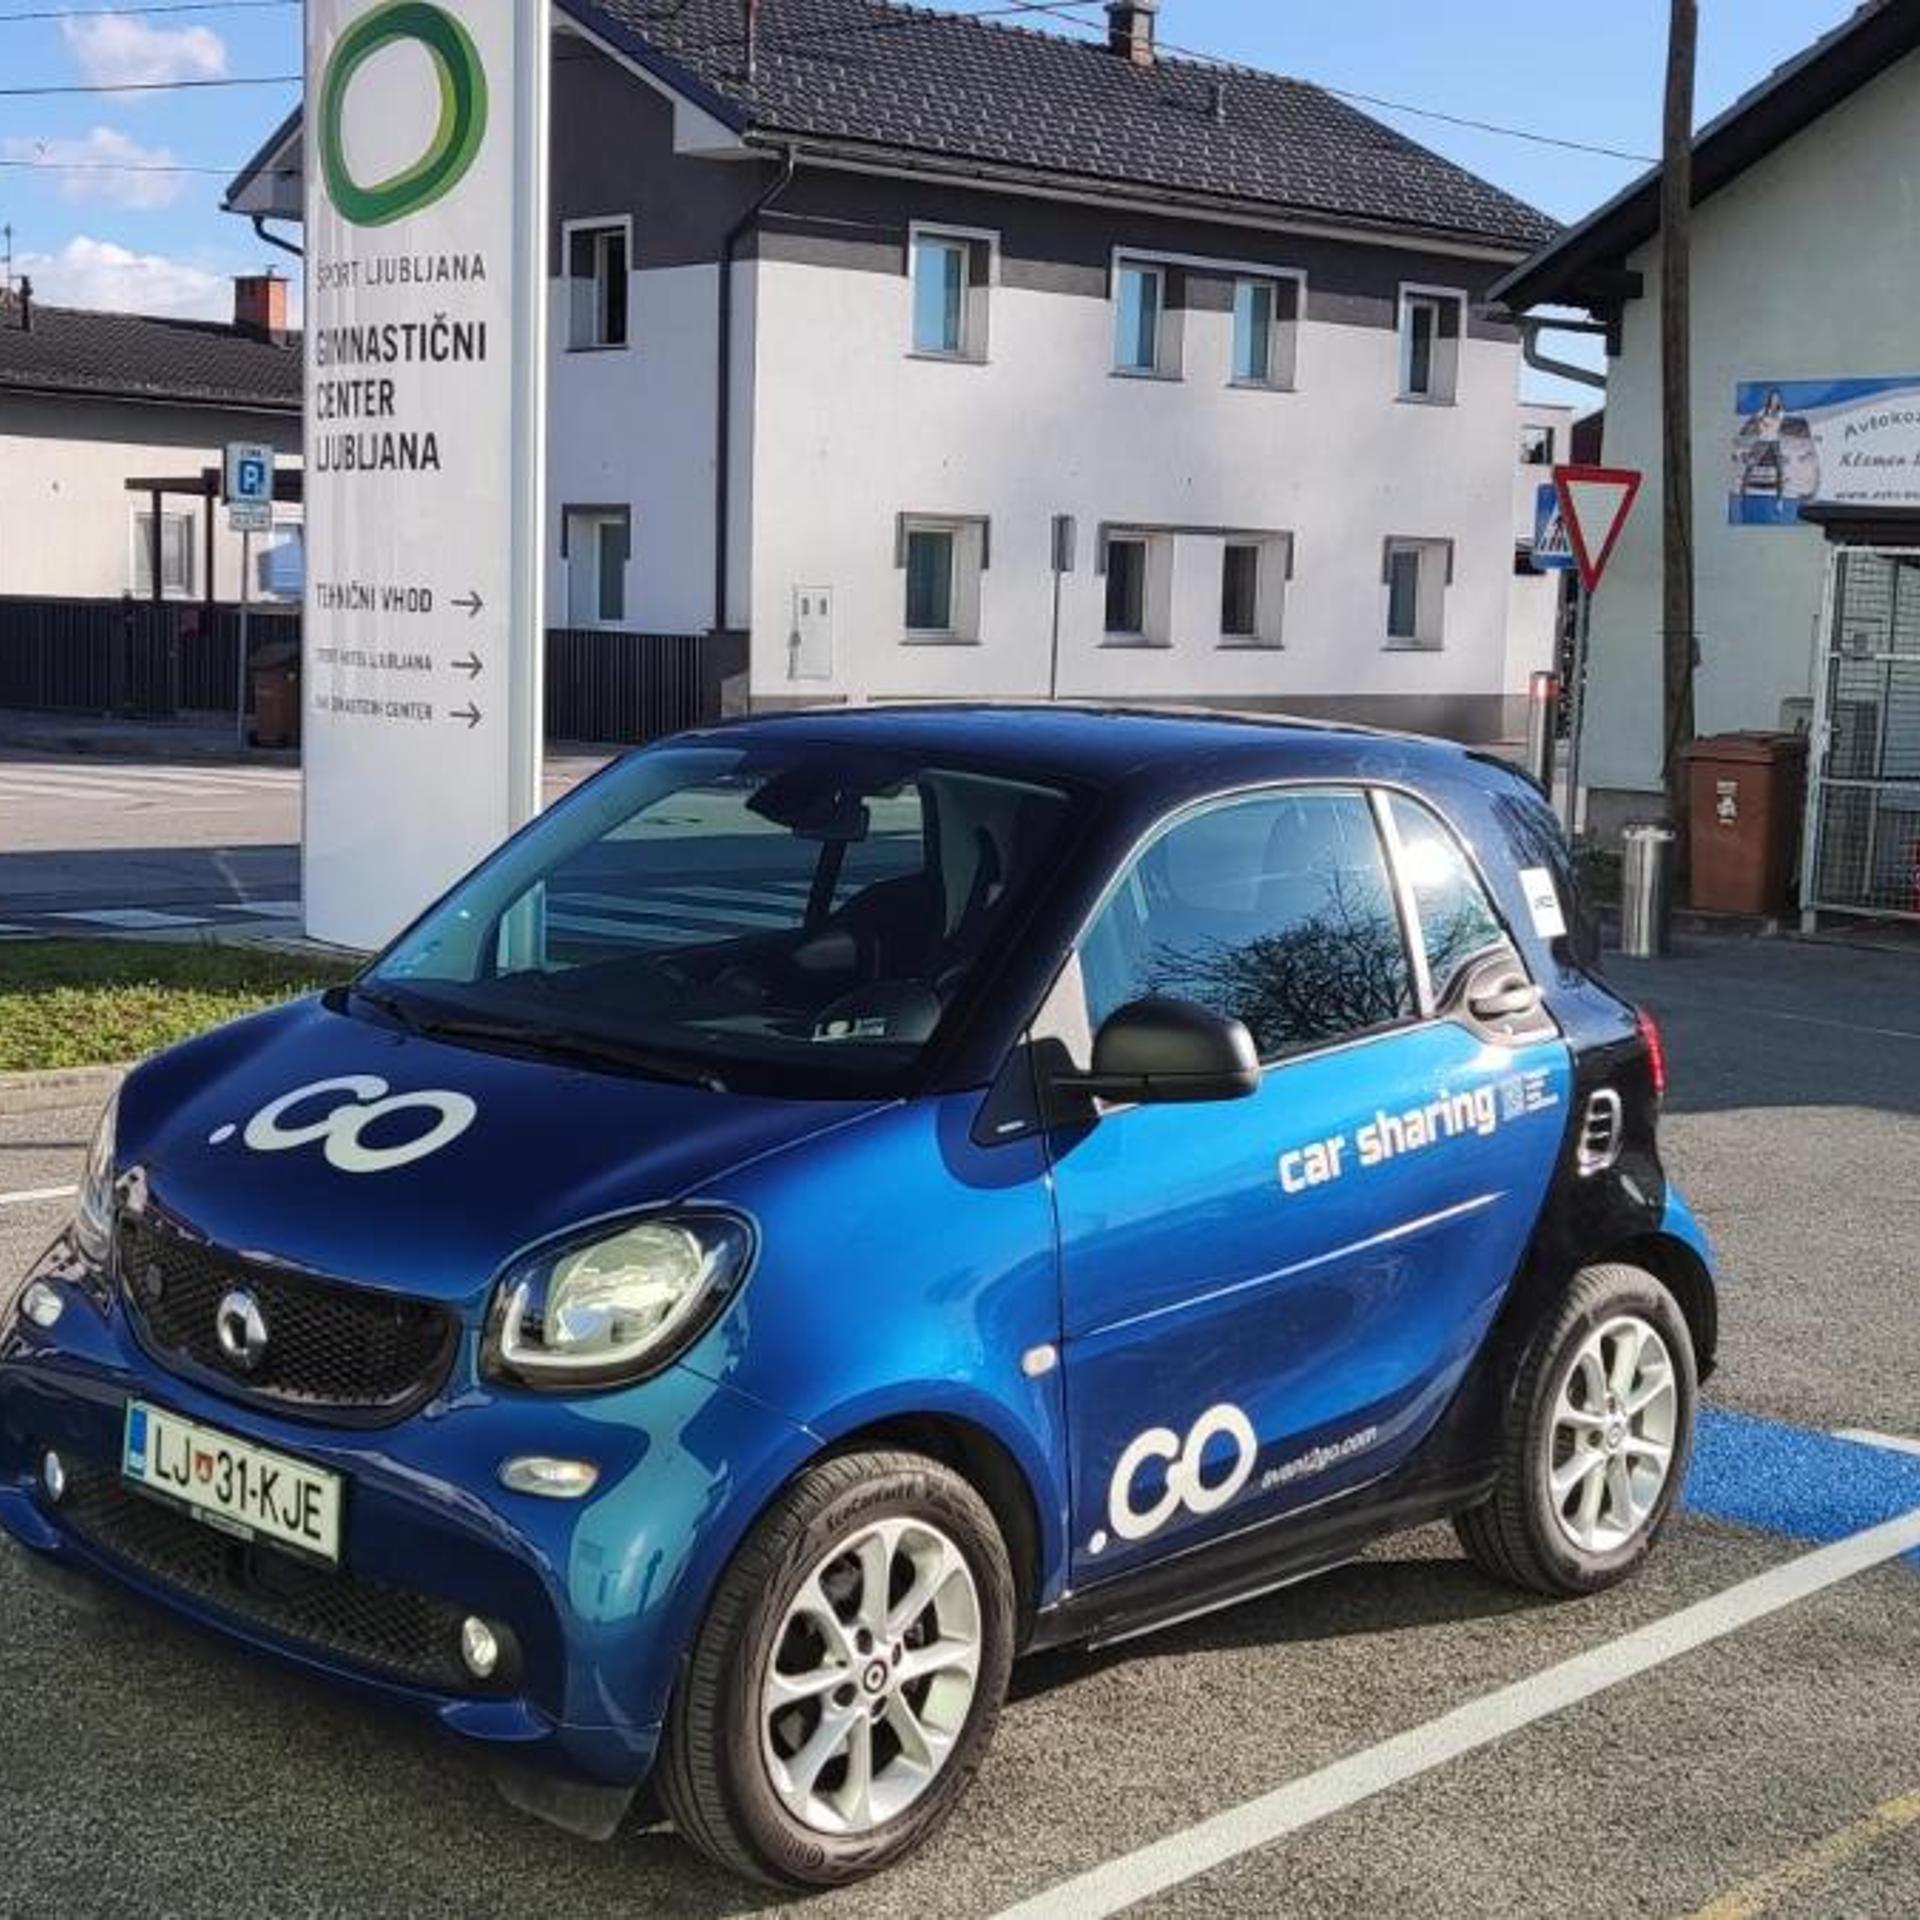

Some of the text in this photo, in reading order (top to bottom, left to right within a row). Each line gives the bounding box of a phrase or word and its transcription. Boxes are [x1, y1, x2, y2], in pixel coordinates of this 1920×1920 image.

[365, 253, 486, 286] LJUBLJANA
[316, 313, 486, 366] GIMNASTIČNI
[316, 378, 396, 420] CENTER
[316, 432, 441, 472] LJUBLJANA
[381, 585, 433, 613] VHOD
[1278, 1135, 1344, 1193] car
[1355, 1086, 1499, 1168] sharing
[154, 1424, 191, 1488] LJ
[215, 1450, 323, 1540] 31-KJE
